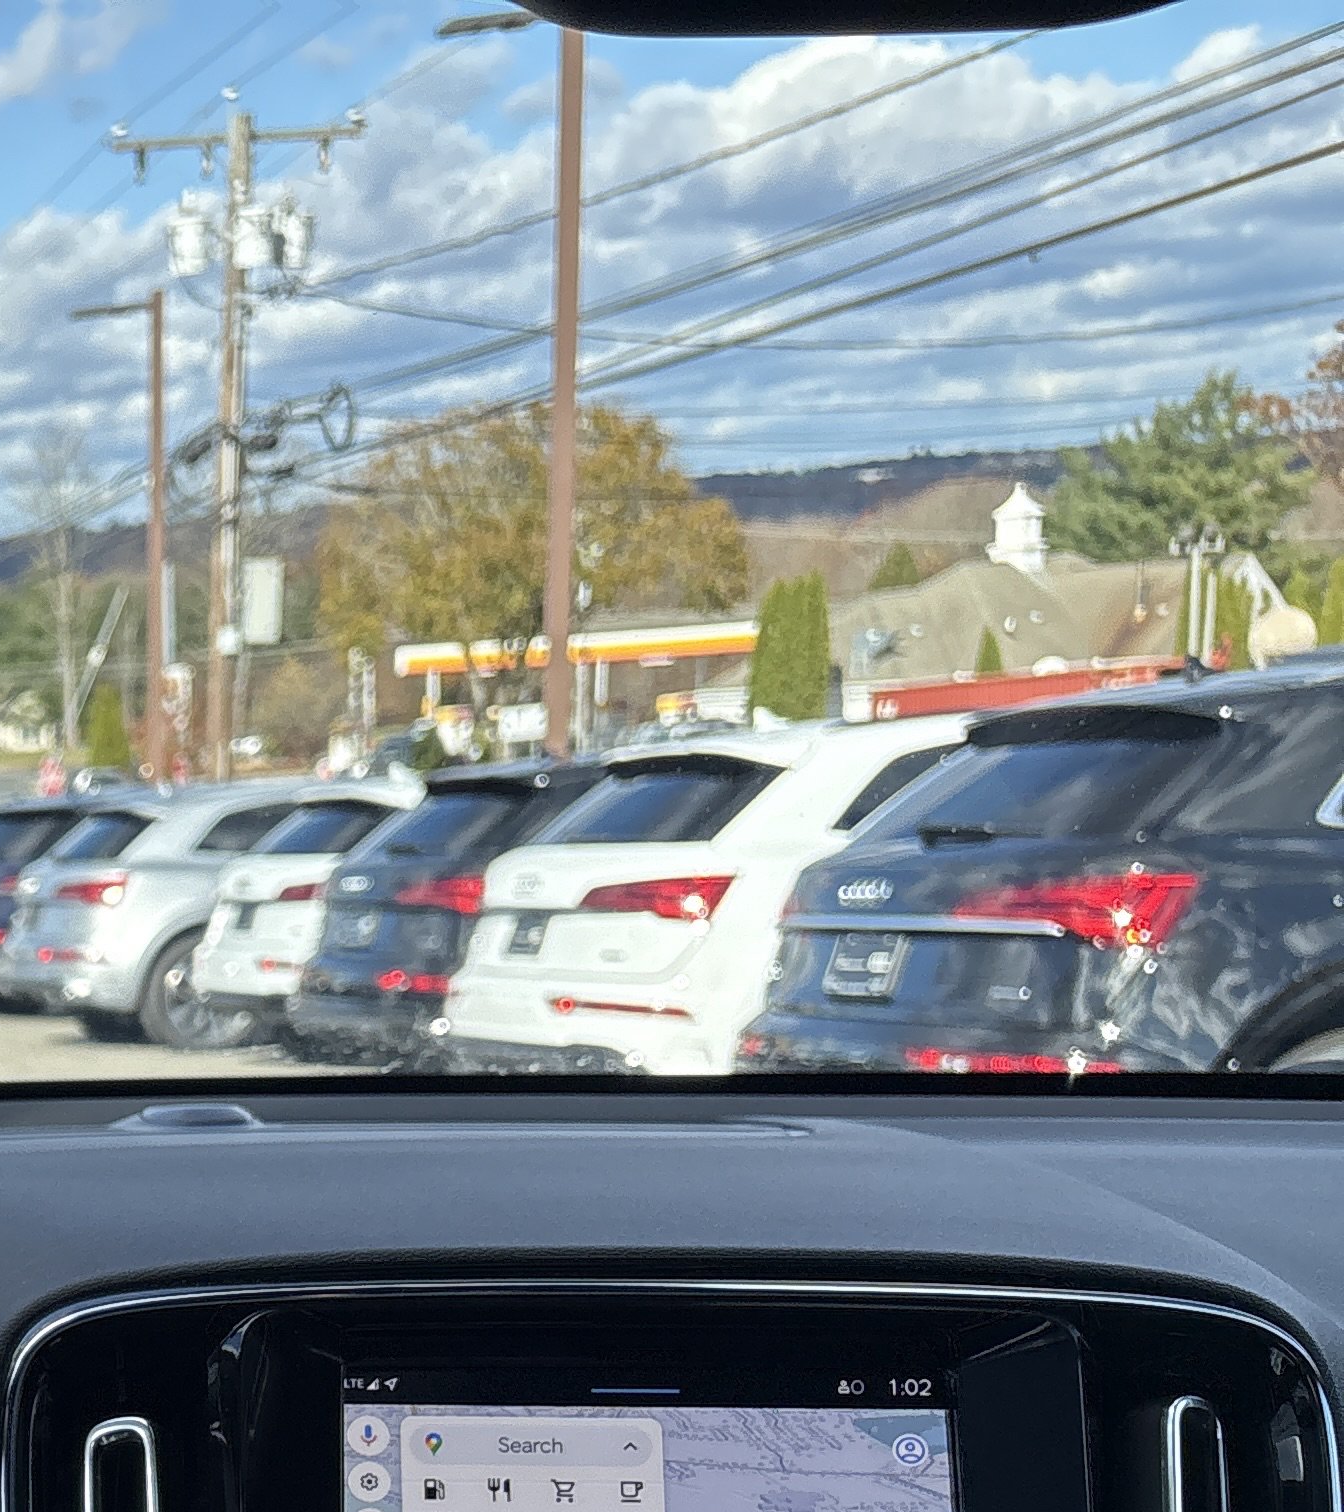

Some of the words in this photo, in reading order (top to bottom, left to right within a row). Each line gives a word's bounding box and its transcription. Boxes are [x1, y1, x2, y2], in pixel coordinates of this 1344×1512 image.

[344, 1378, 364, 1389] LTE
[889, 1378, 932, 1396] 1:02
[498, 1437, 563, 1453] Search
